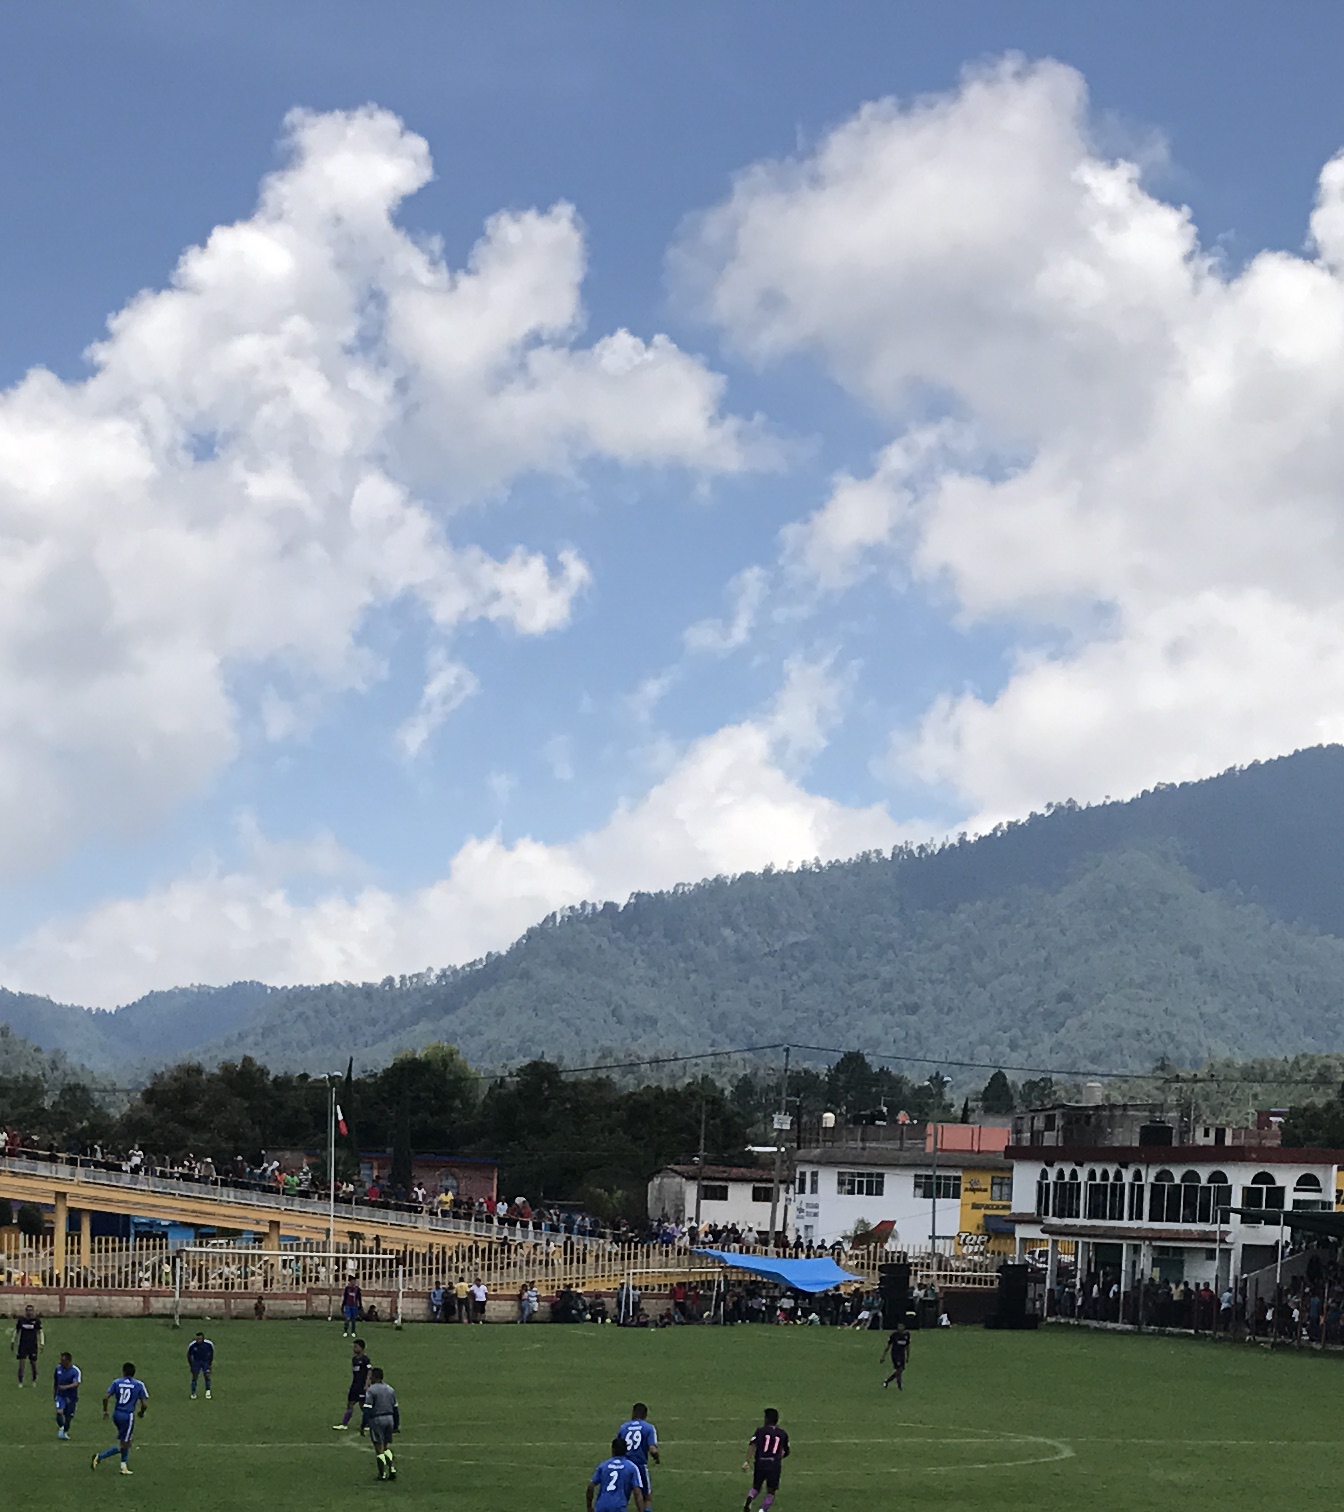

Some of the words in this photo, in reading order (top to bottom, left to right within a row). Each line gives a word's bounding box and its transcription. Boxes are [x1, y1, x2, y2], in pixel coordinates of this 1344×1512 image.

[119, 1388, 131, 1404] 10
[764, 1434, 780, 1454] 11
[607, 1470, 618, 1491] 2
